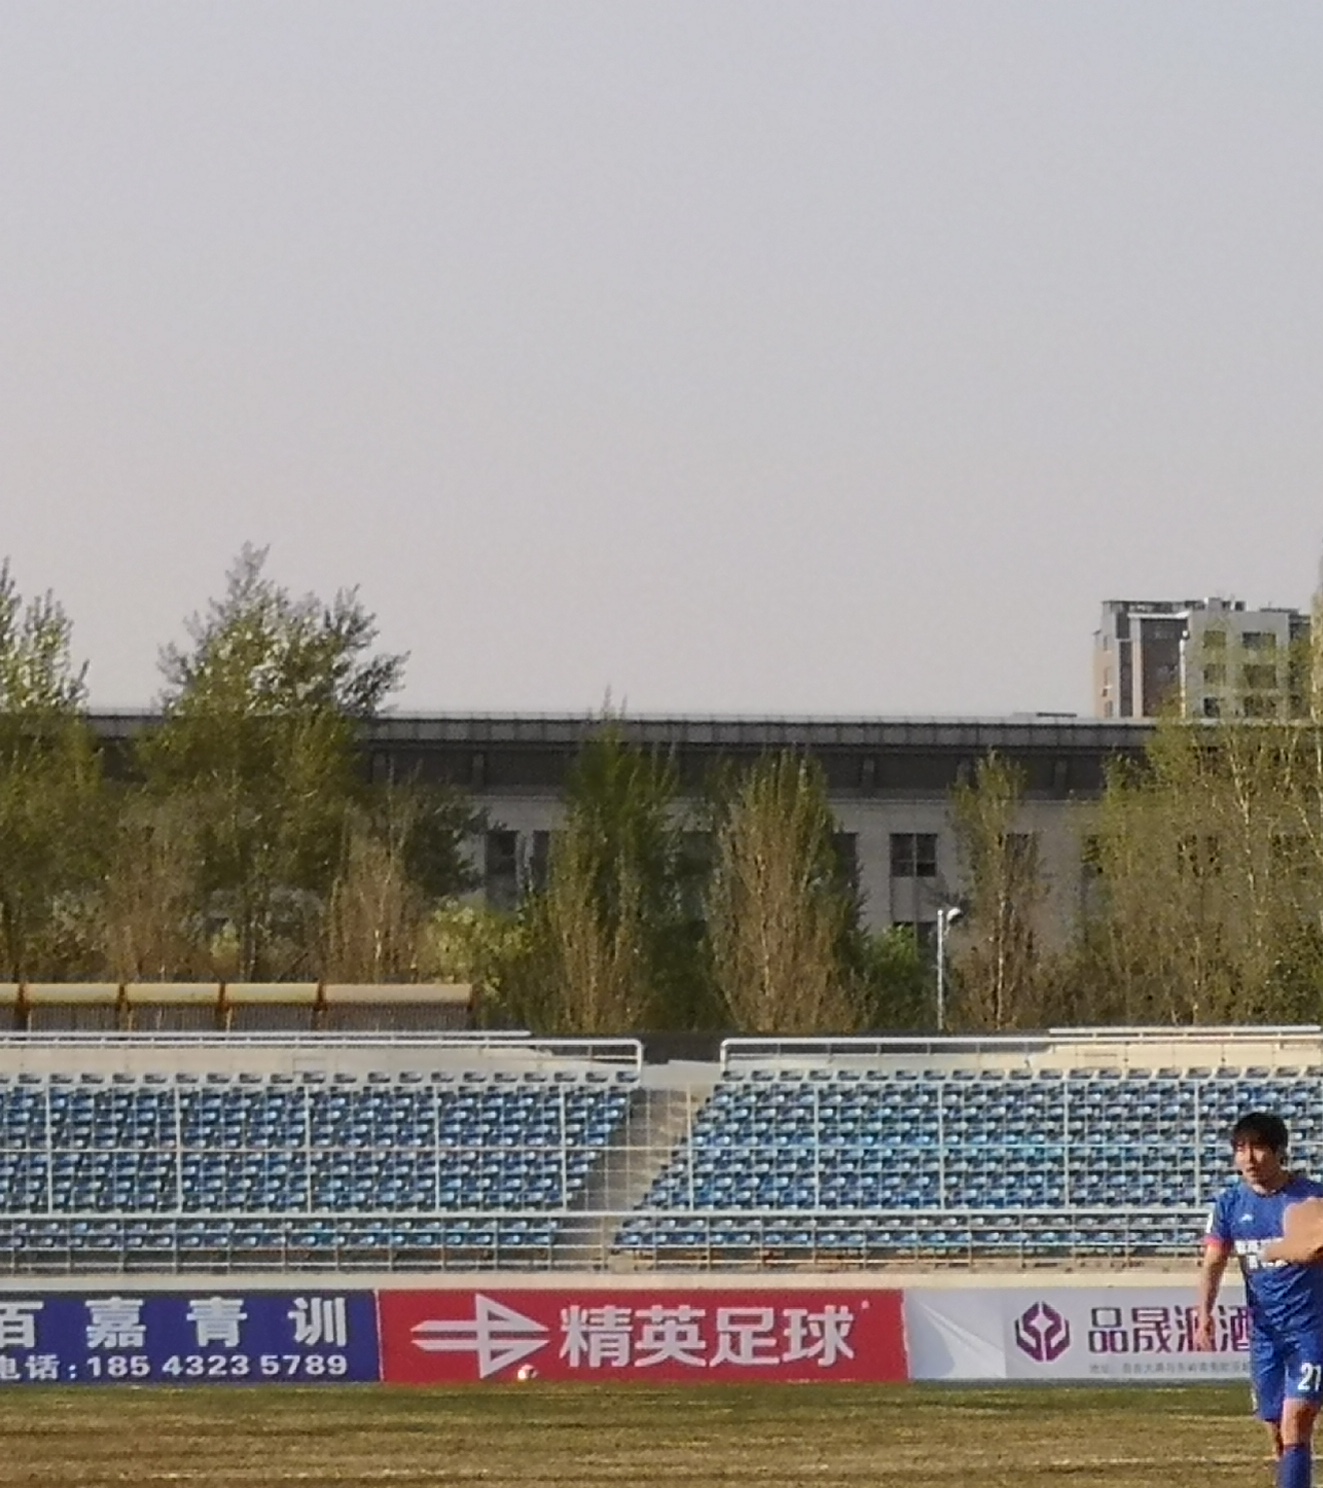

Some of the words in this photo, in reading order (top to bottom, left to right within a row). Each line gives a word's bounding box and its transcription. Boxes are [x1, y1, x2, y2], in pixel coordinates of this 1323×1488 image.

[0, 1296, 348, 1350] 百嘉青训
[559, 1304, 855, 1368] 精英足球
[87, 1355, 150, 1377] 185
[162, 1355, 250, 1377] 4323
[260, 1355, 348, 1377] 5789
[1297, 1362, 1321, 1392] 21
